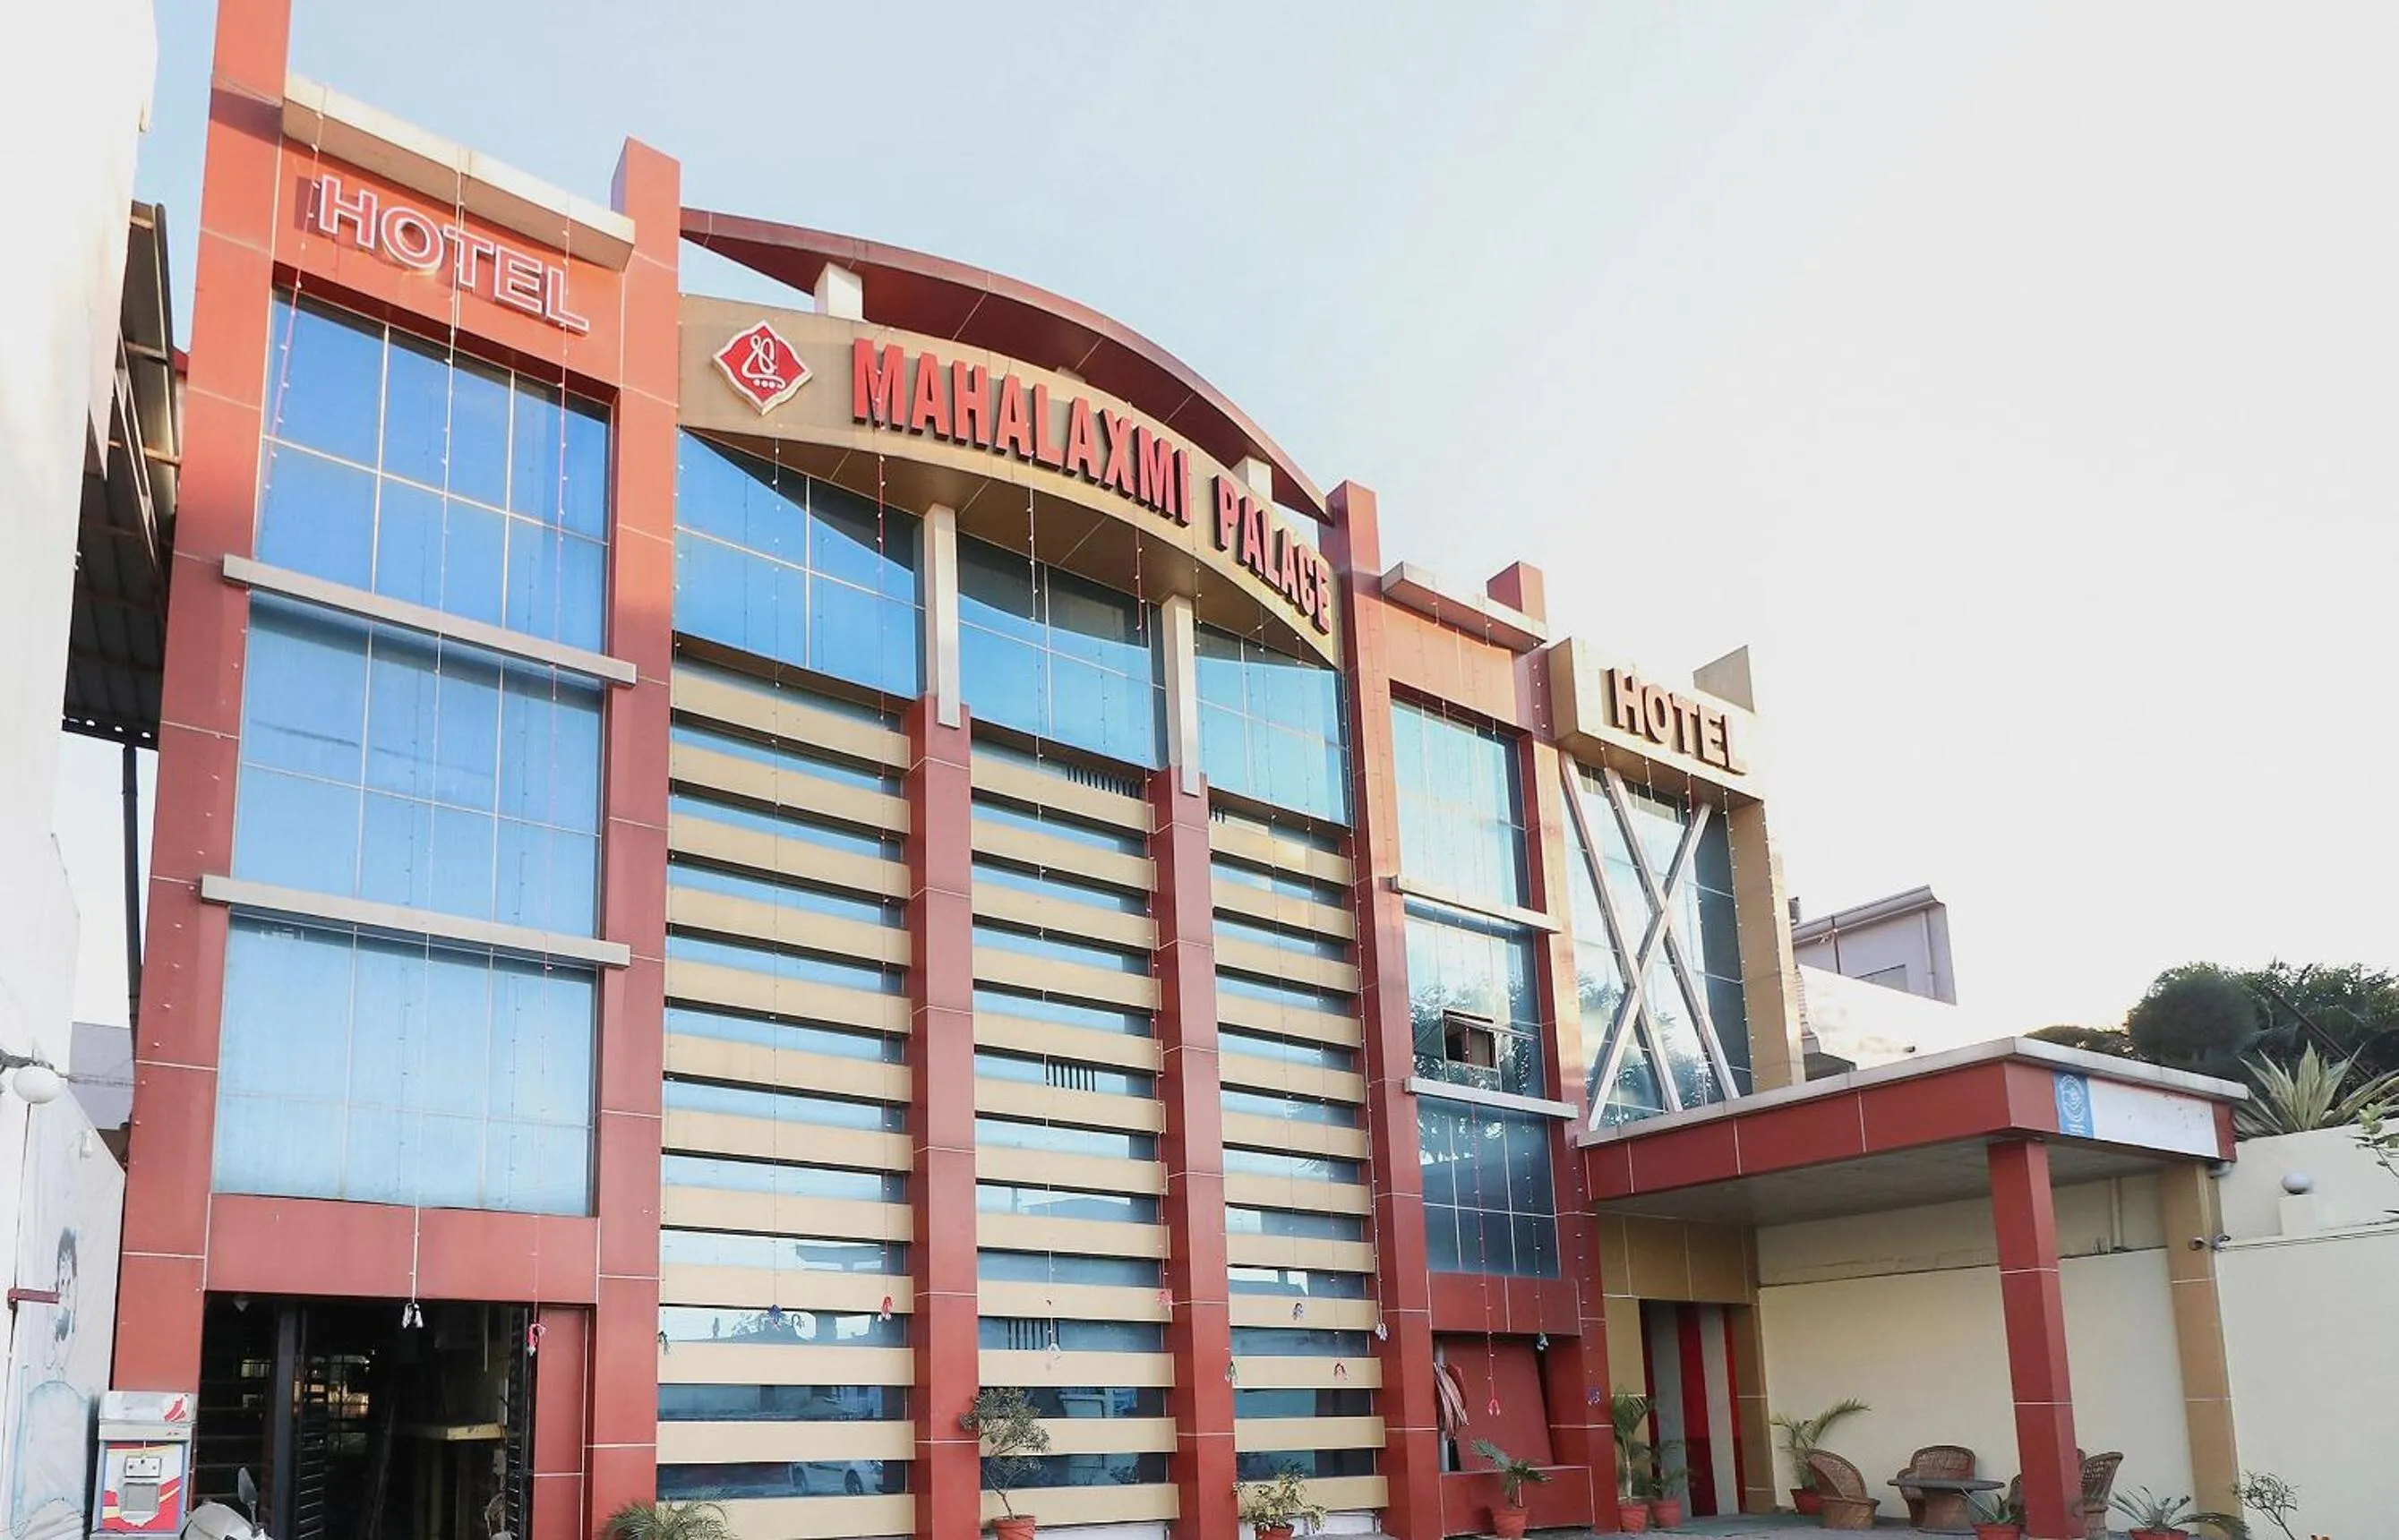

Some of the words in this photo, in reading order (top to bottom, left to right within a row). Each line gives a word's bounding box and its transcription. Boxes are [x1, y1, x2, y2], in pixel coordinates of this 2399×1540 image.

[319, 175, 589, 333] HOTEL
[853, 338, 1191, 528] MAHALAXMI
[1212, 475, 1331, 636] PALACE
[1609, 668, 1748, 775] HOTEL
